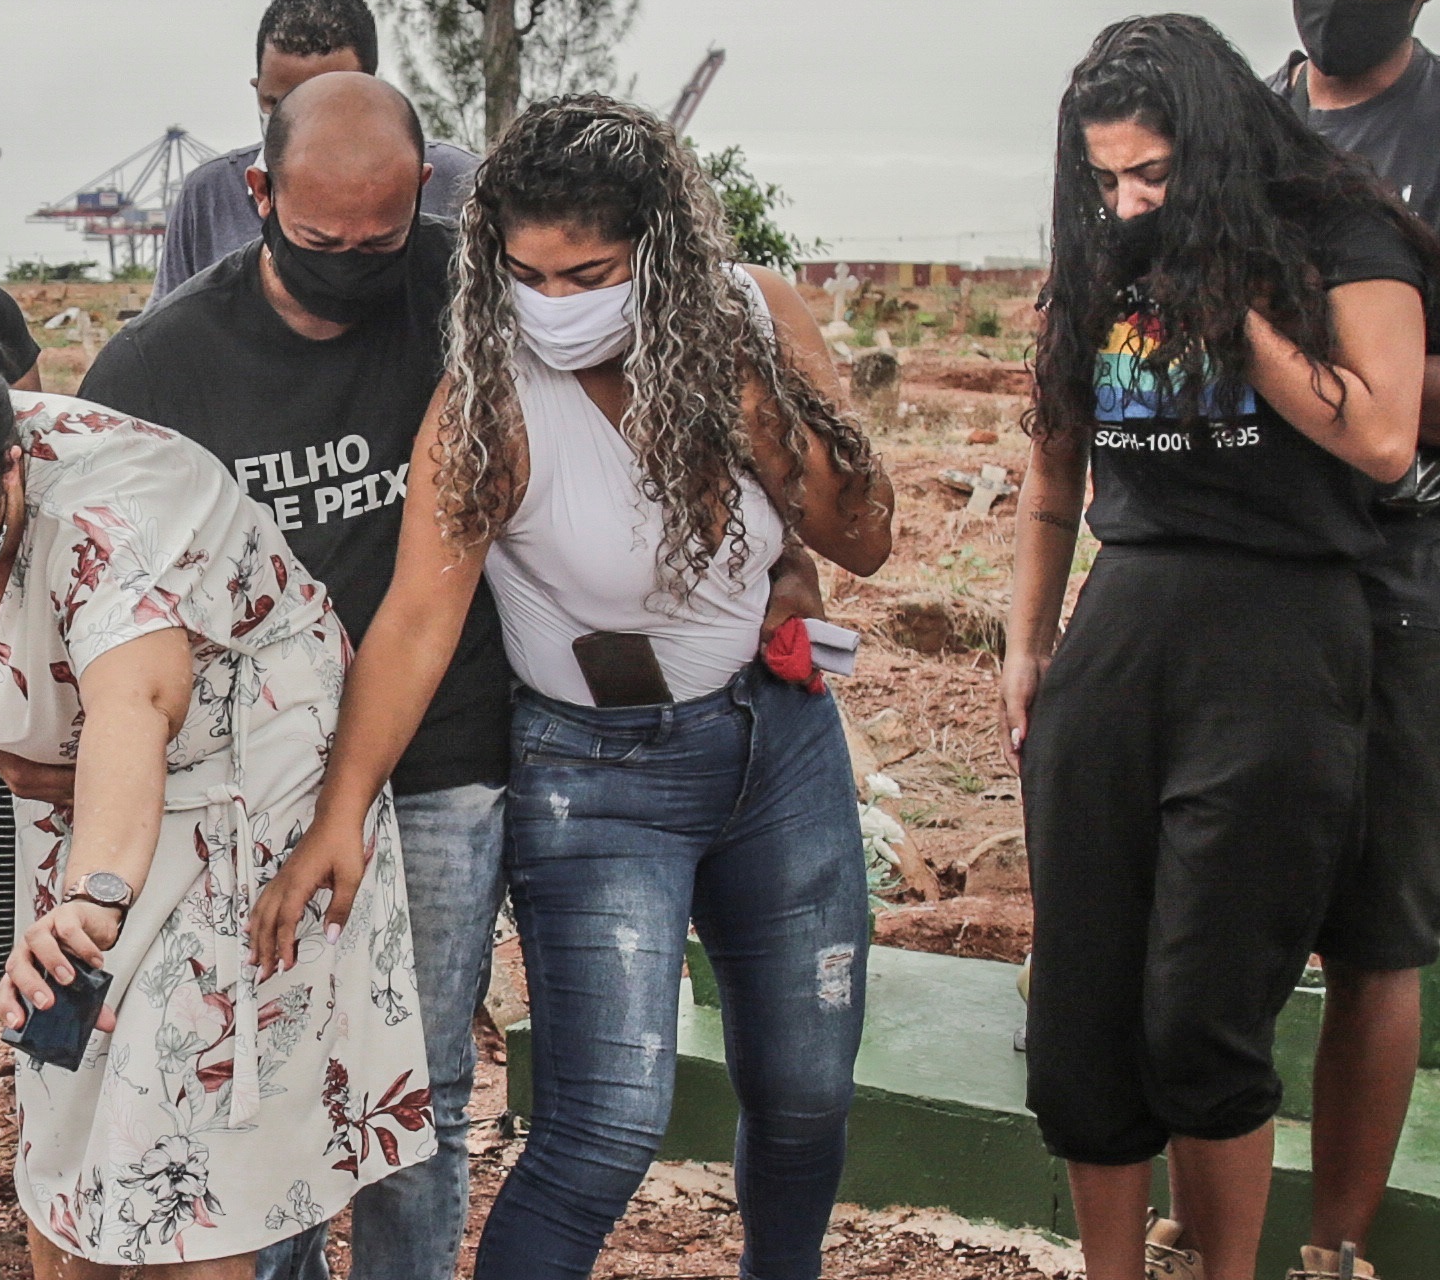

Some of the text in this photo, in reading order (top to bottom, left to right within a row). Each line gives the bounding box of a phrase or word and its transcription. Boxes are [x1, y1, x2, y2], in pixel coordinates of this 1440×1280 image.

[235, 434, 370, 494] FILHO
[1094, 426, 1260, 453] SCPH-1001 1995
[314, 462, 410, 524] PEIX
